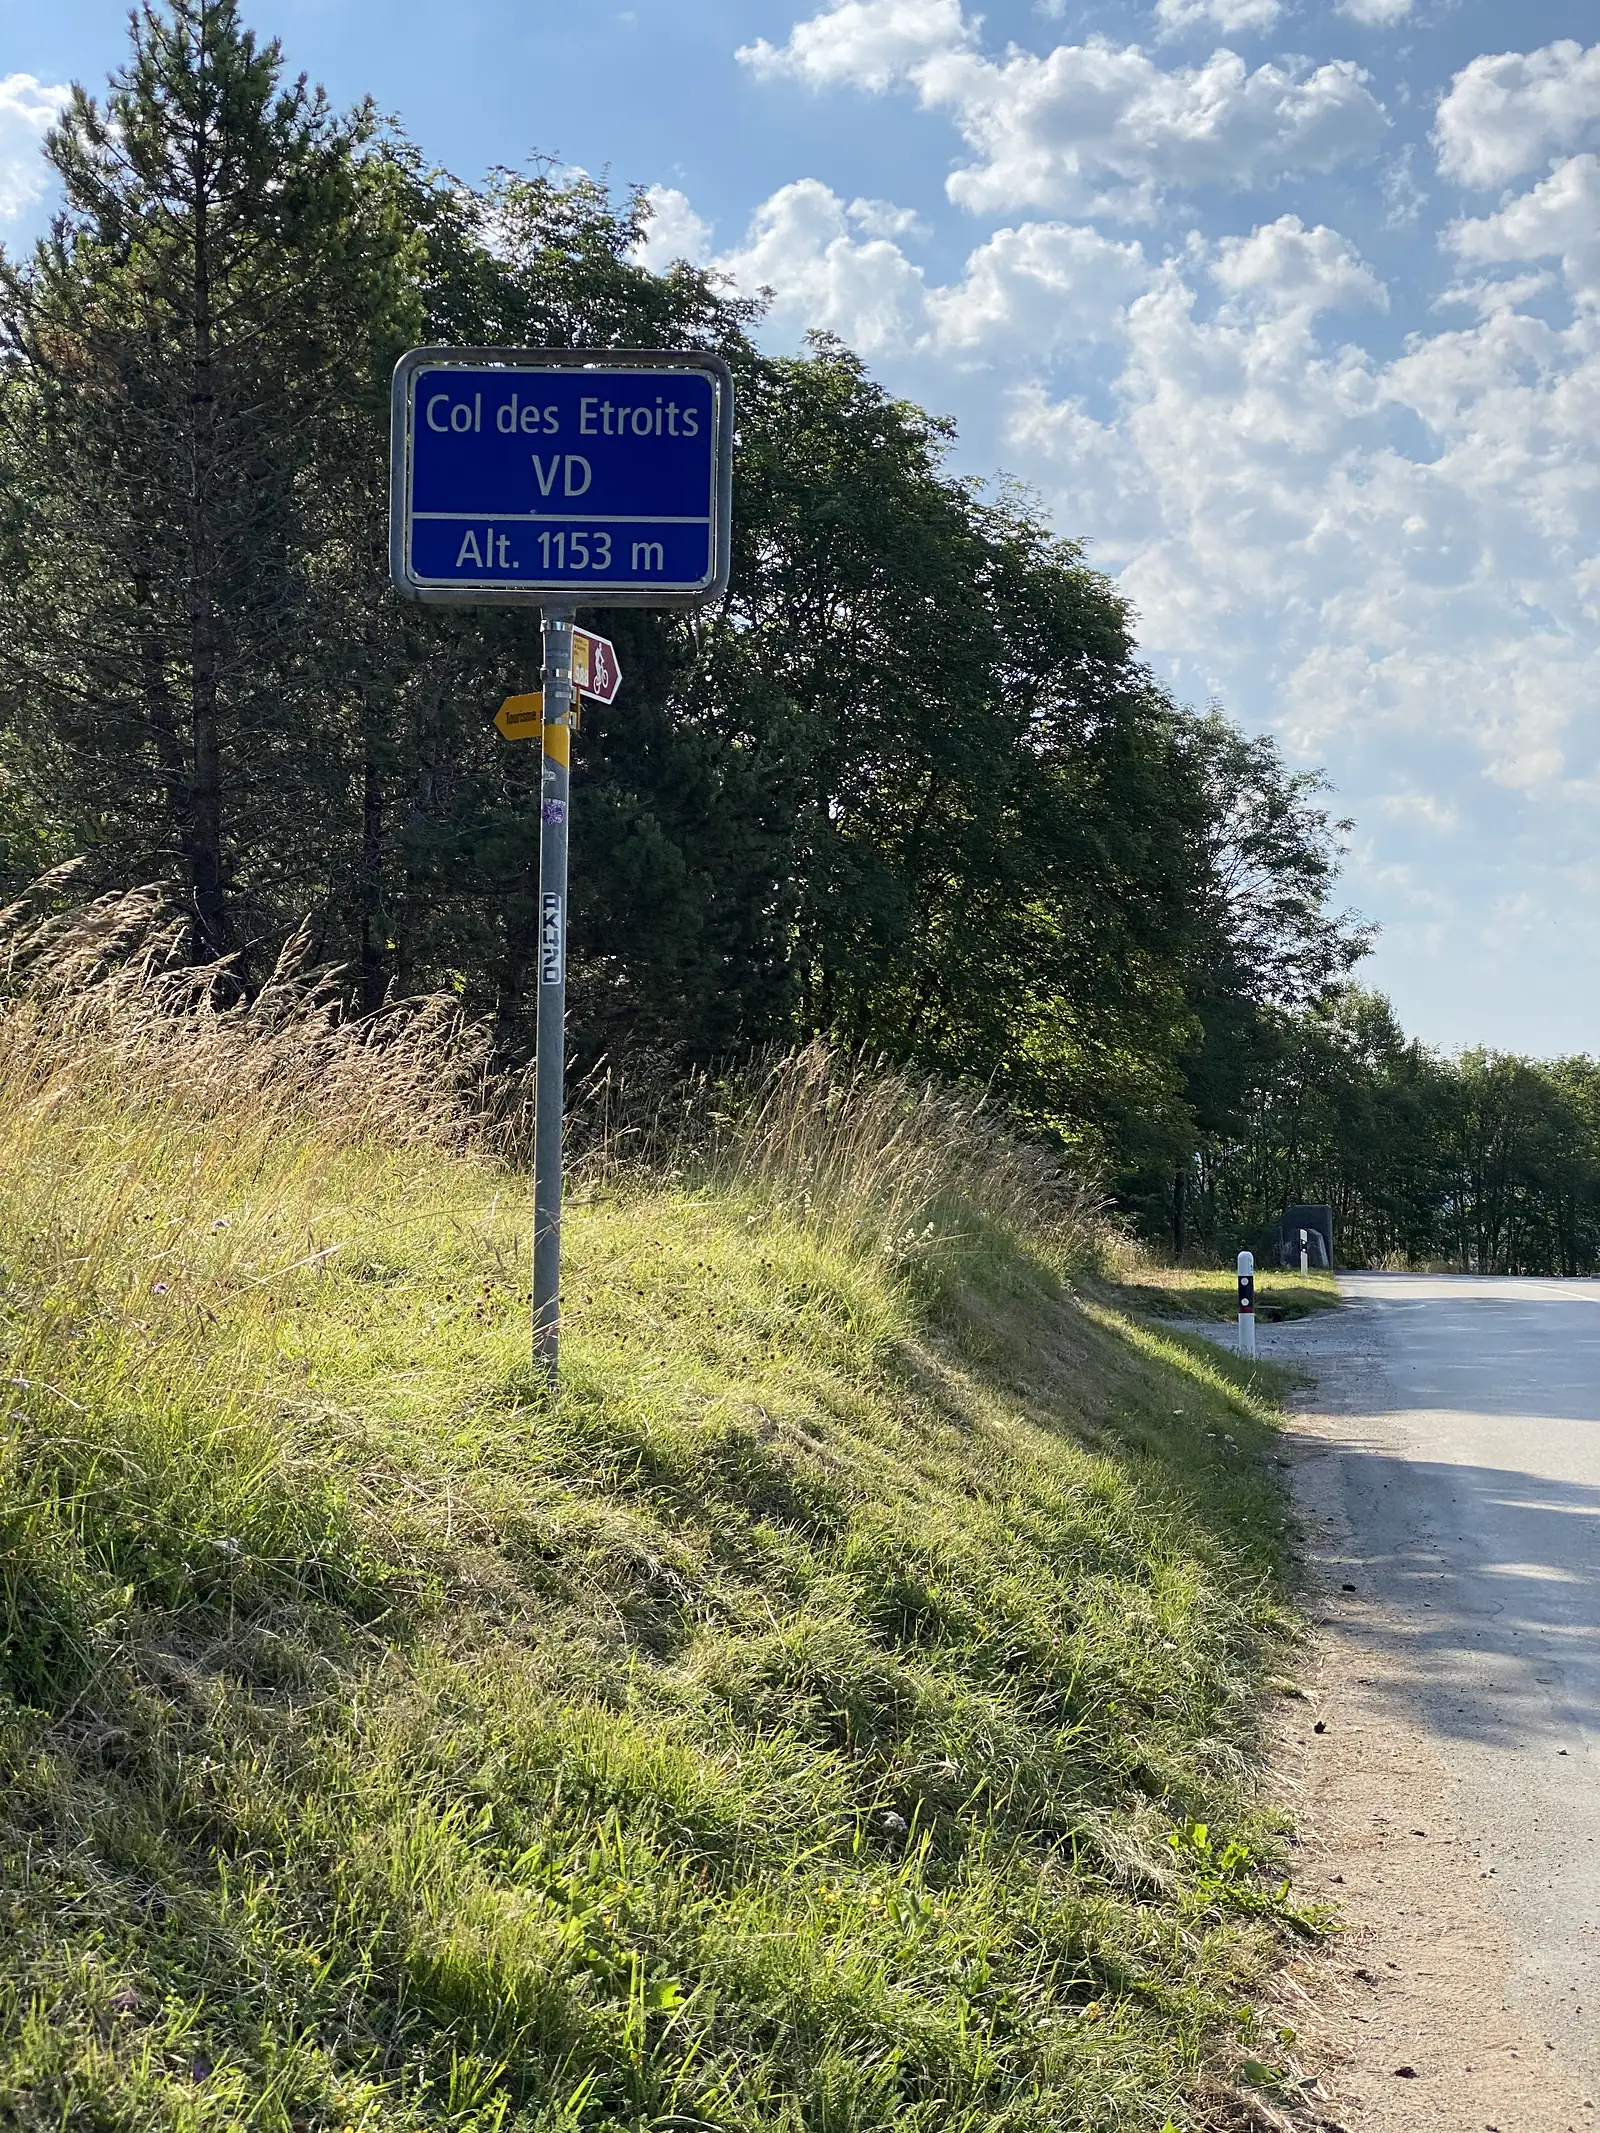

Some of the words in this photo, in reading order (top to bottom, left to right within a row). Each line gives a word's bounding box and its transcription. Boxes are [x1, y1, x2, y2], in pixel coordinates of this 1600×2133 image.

[427, 393, 481, 433] Col
[496, 394, 559, 433] des
[580, 397, 699, 436] Etroits
[532, 455, 592, 496] VD
[456, 528, 519, 568] Alt.
[538, 531, 611, 569] 1153
[632, 542, 663, 570] m
[505, 710, 537, 725] Tourisme
